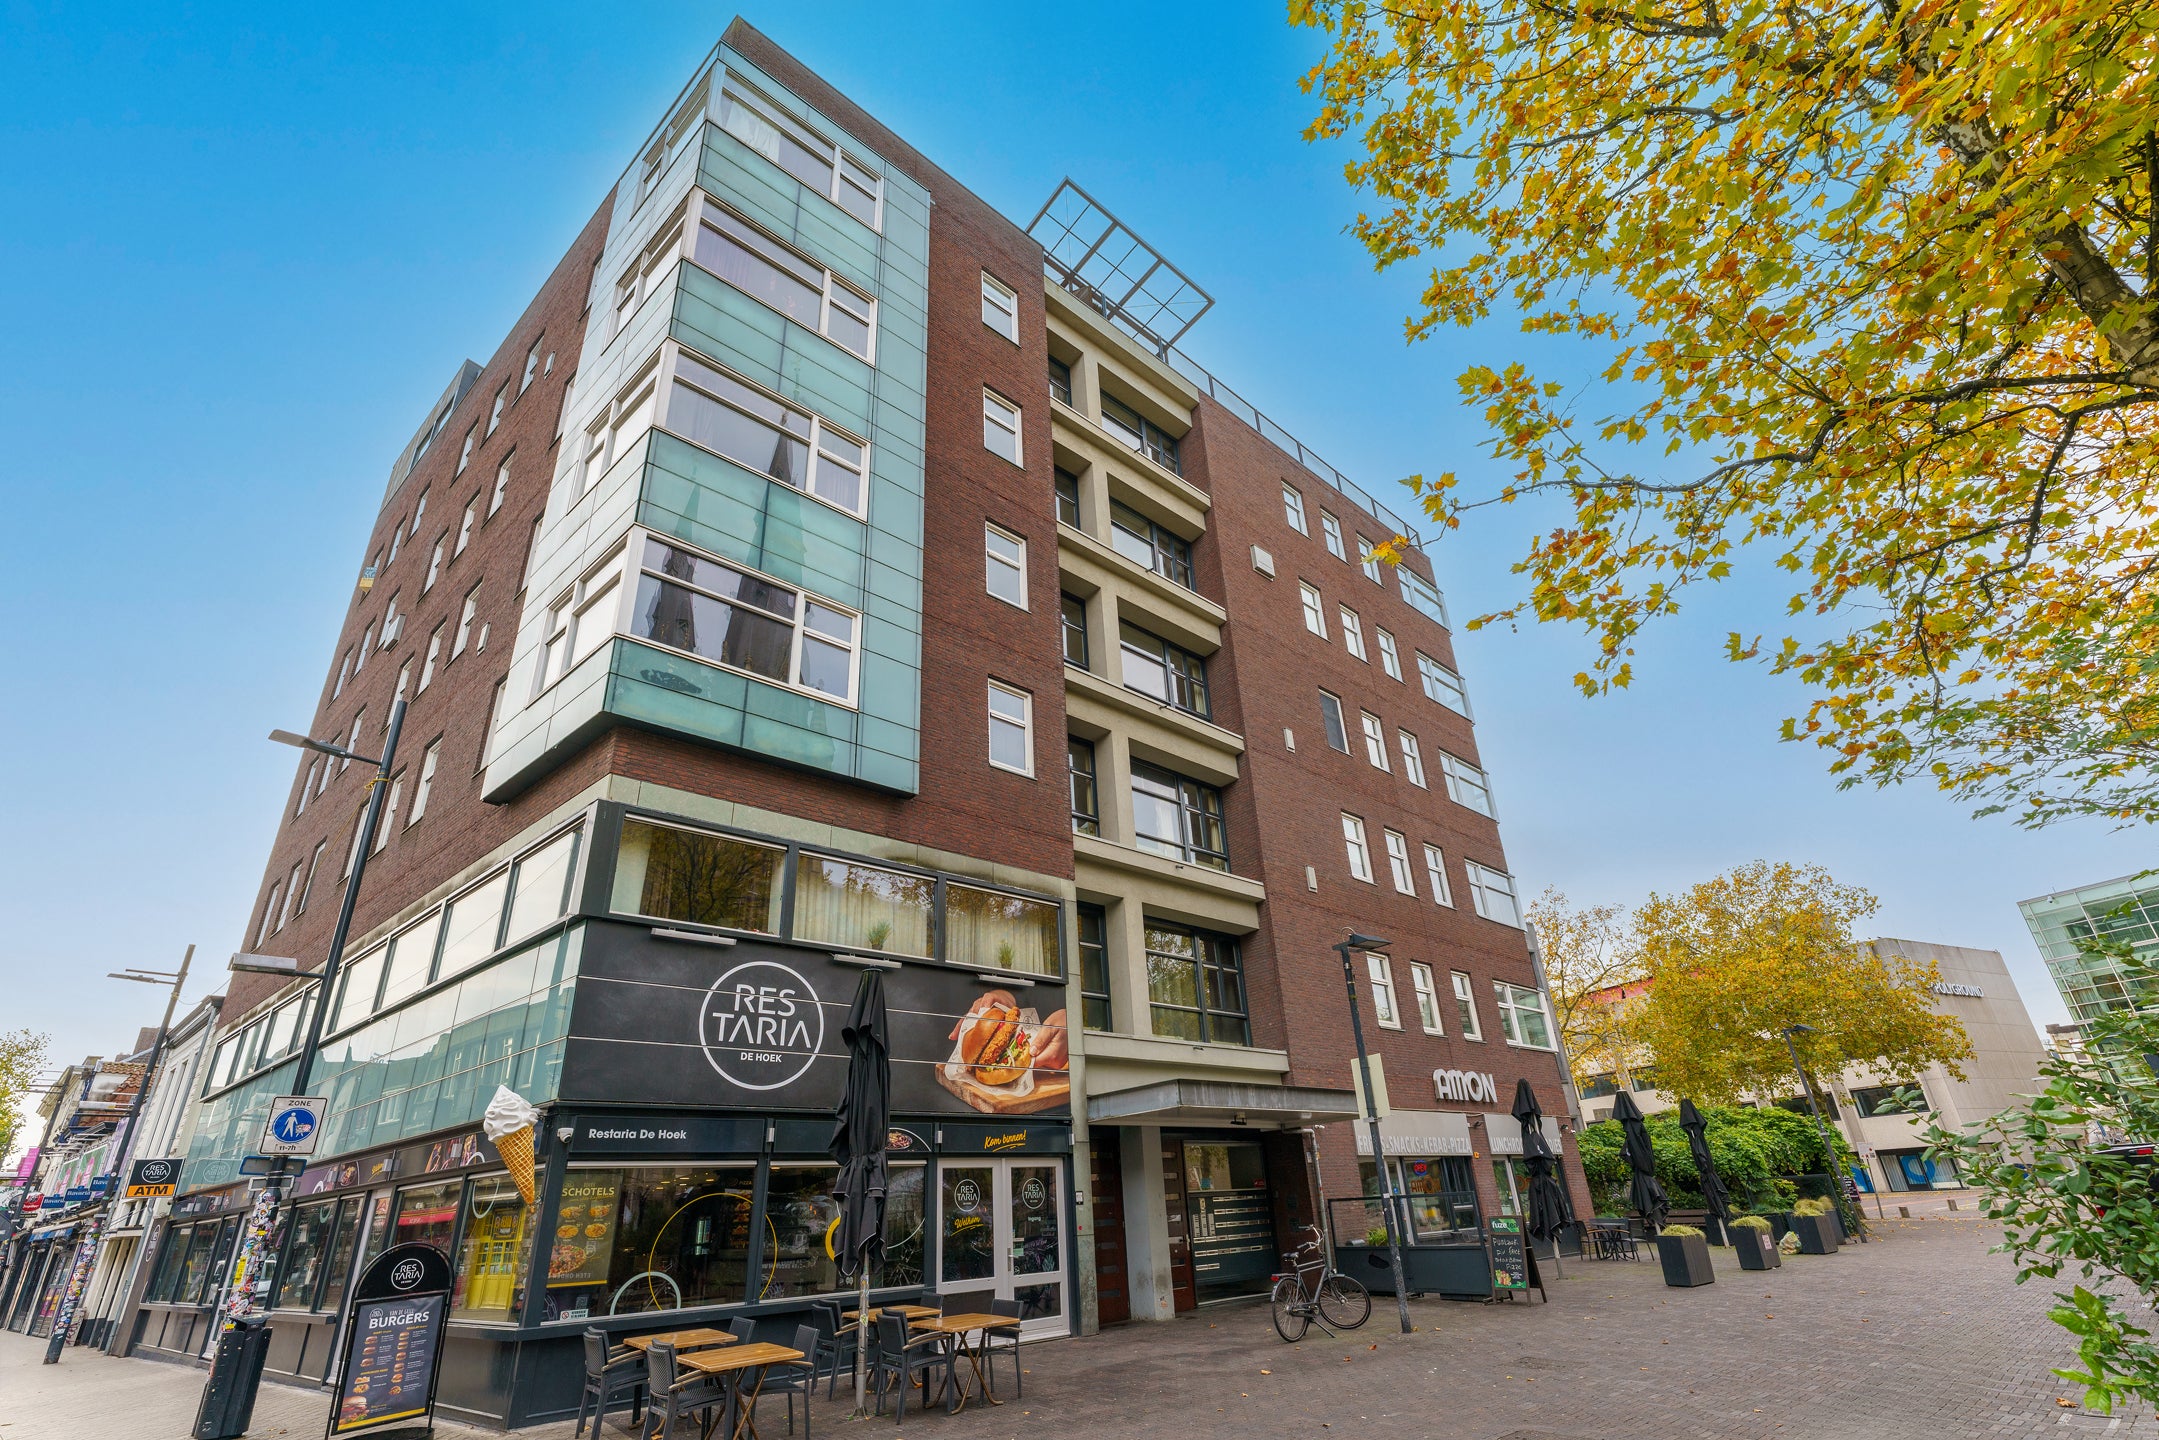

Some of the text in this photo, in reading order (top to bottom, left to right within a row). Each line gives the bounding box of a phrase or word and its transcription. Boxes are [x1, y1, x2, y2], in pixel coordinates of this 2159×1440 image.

[734, 984, 796, 1017] RES
[712, 1012, 811, 1048] TARIA
[740, 1052, 782, 1063] DE HOEK
[1432, 1068, 1498, 1103] AMON
[588, 1128, 687, 1140] Restaria De Hoek
[983, 1136, 1002, 1150] Kom
[134, 1185, 169, 1196] ATM
[561, 1187, 616, 1197] SCHOTELS
[960, 1185, 974, 1194] RES
[1027, 1183, 1040, 1192] RES
[957, 1193, 978, 1201] TARIA
[1024, 1191, 1043, 1199] TARIA
[954, 1215, 981, 1229] Welkom
[400, 1264, 417, 1273] RES
[394, 1271, 421, 1281] TARIA
[369, 1311, 430, 1329] BURGERS
